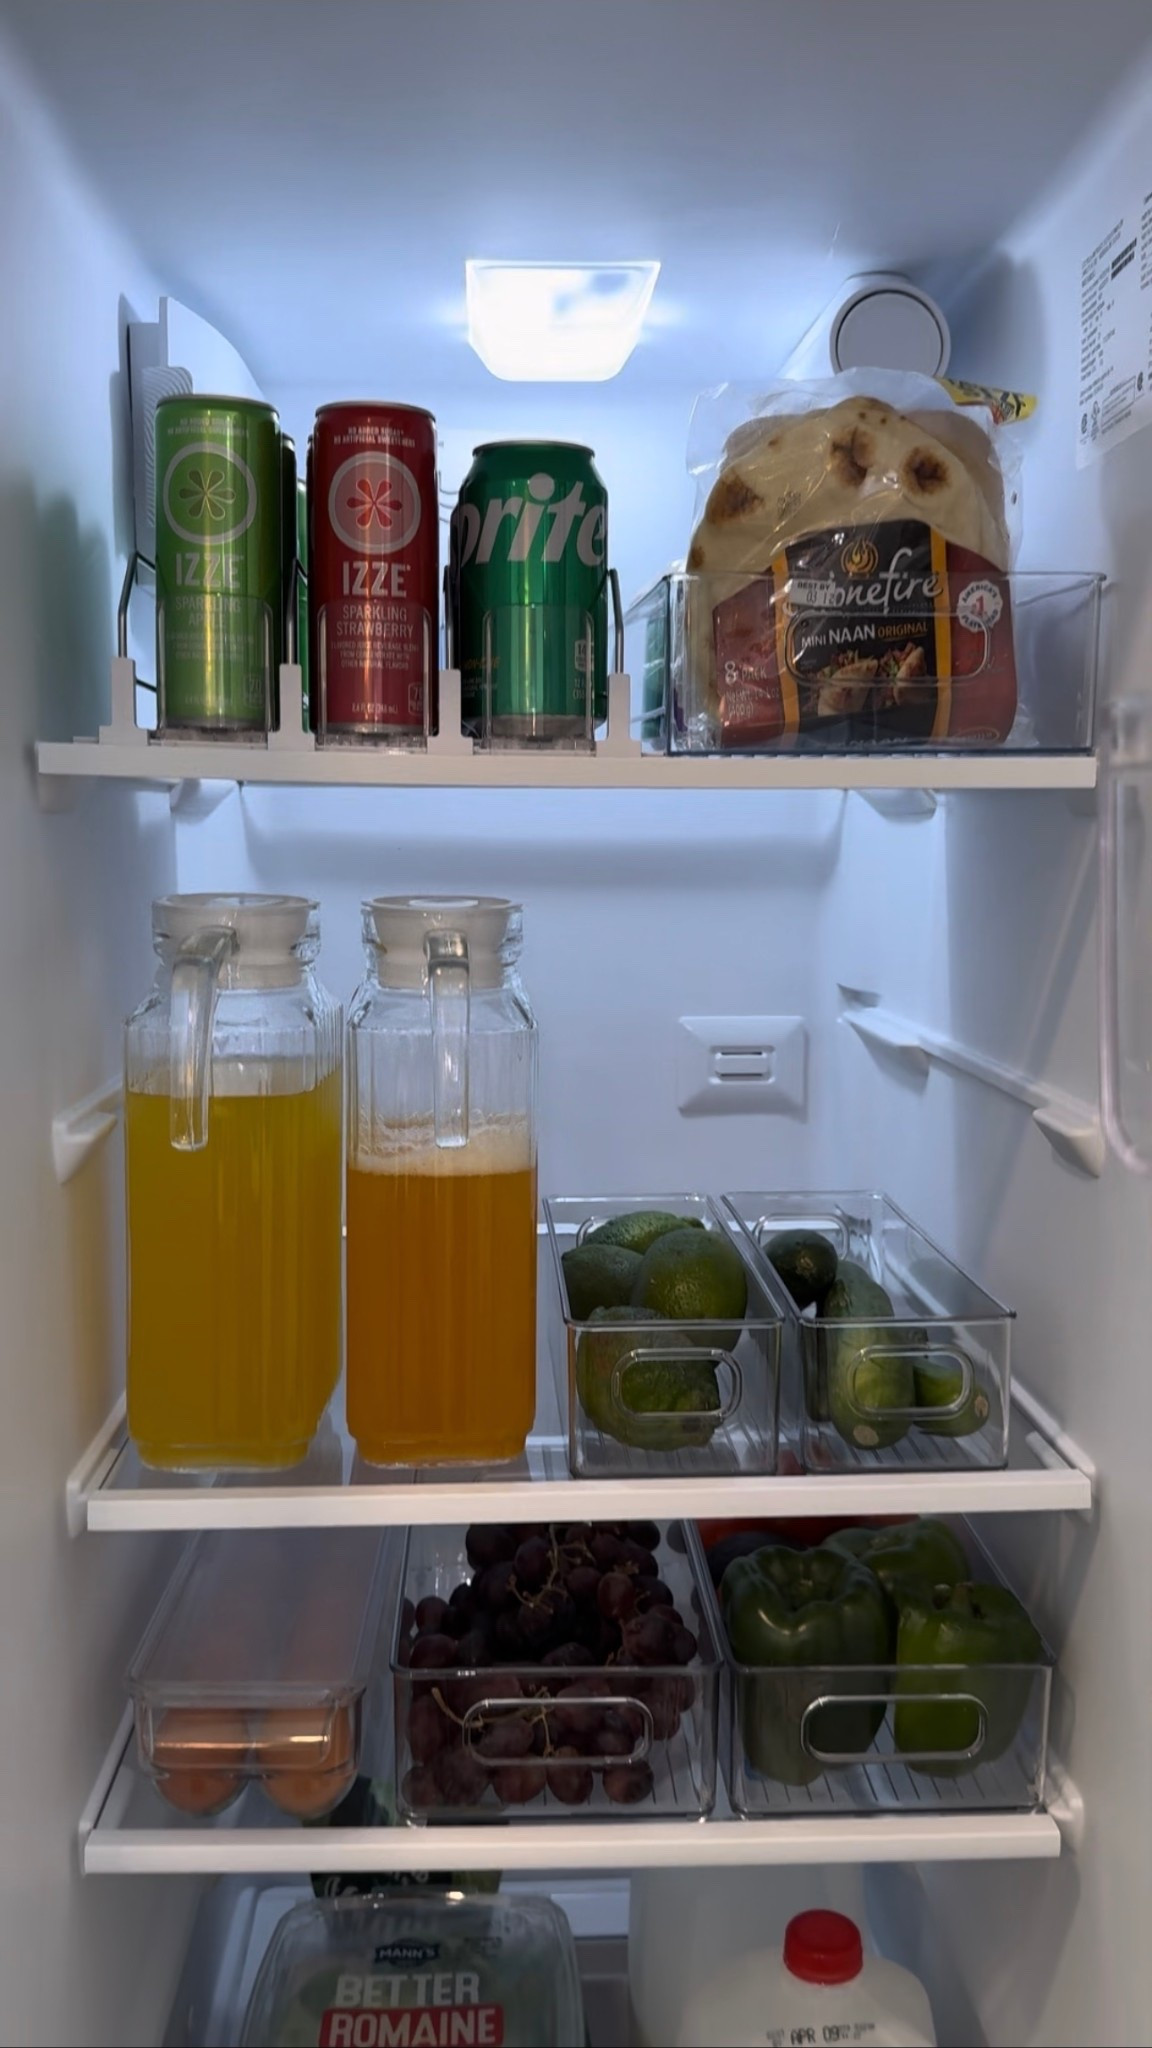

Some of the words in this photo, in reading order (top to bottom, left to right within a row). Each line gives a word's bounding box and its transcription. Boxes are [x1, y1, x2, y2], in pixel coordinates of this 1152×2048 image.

[175, 553, 240, 589] IZZE
[342, 561, 408, 598] IZZE
[797, 581, 817, 590] BEST
[819, 583, 830, 591] BY
[342, 604, 408, 622] SPARKLING
[336, 623, 414, 639] STRAWBERRY
[801, 634, 827, 648] MINI
[829, 623, 876, 644] NAAN
[878, 621, 928, 639] ORIGINAL
[725, 660, 737, 684] 8
[741, 664, 767, 681] PACK
[378, 1948, 436, 1960] MANN'S
[335, 1971, 480, 2007] BETTER
[328, 2008, 497, 2047] ROMAINE
[790, 2027, 816, 2046] APR
